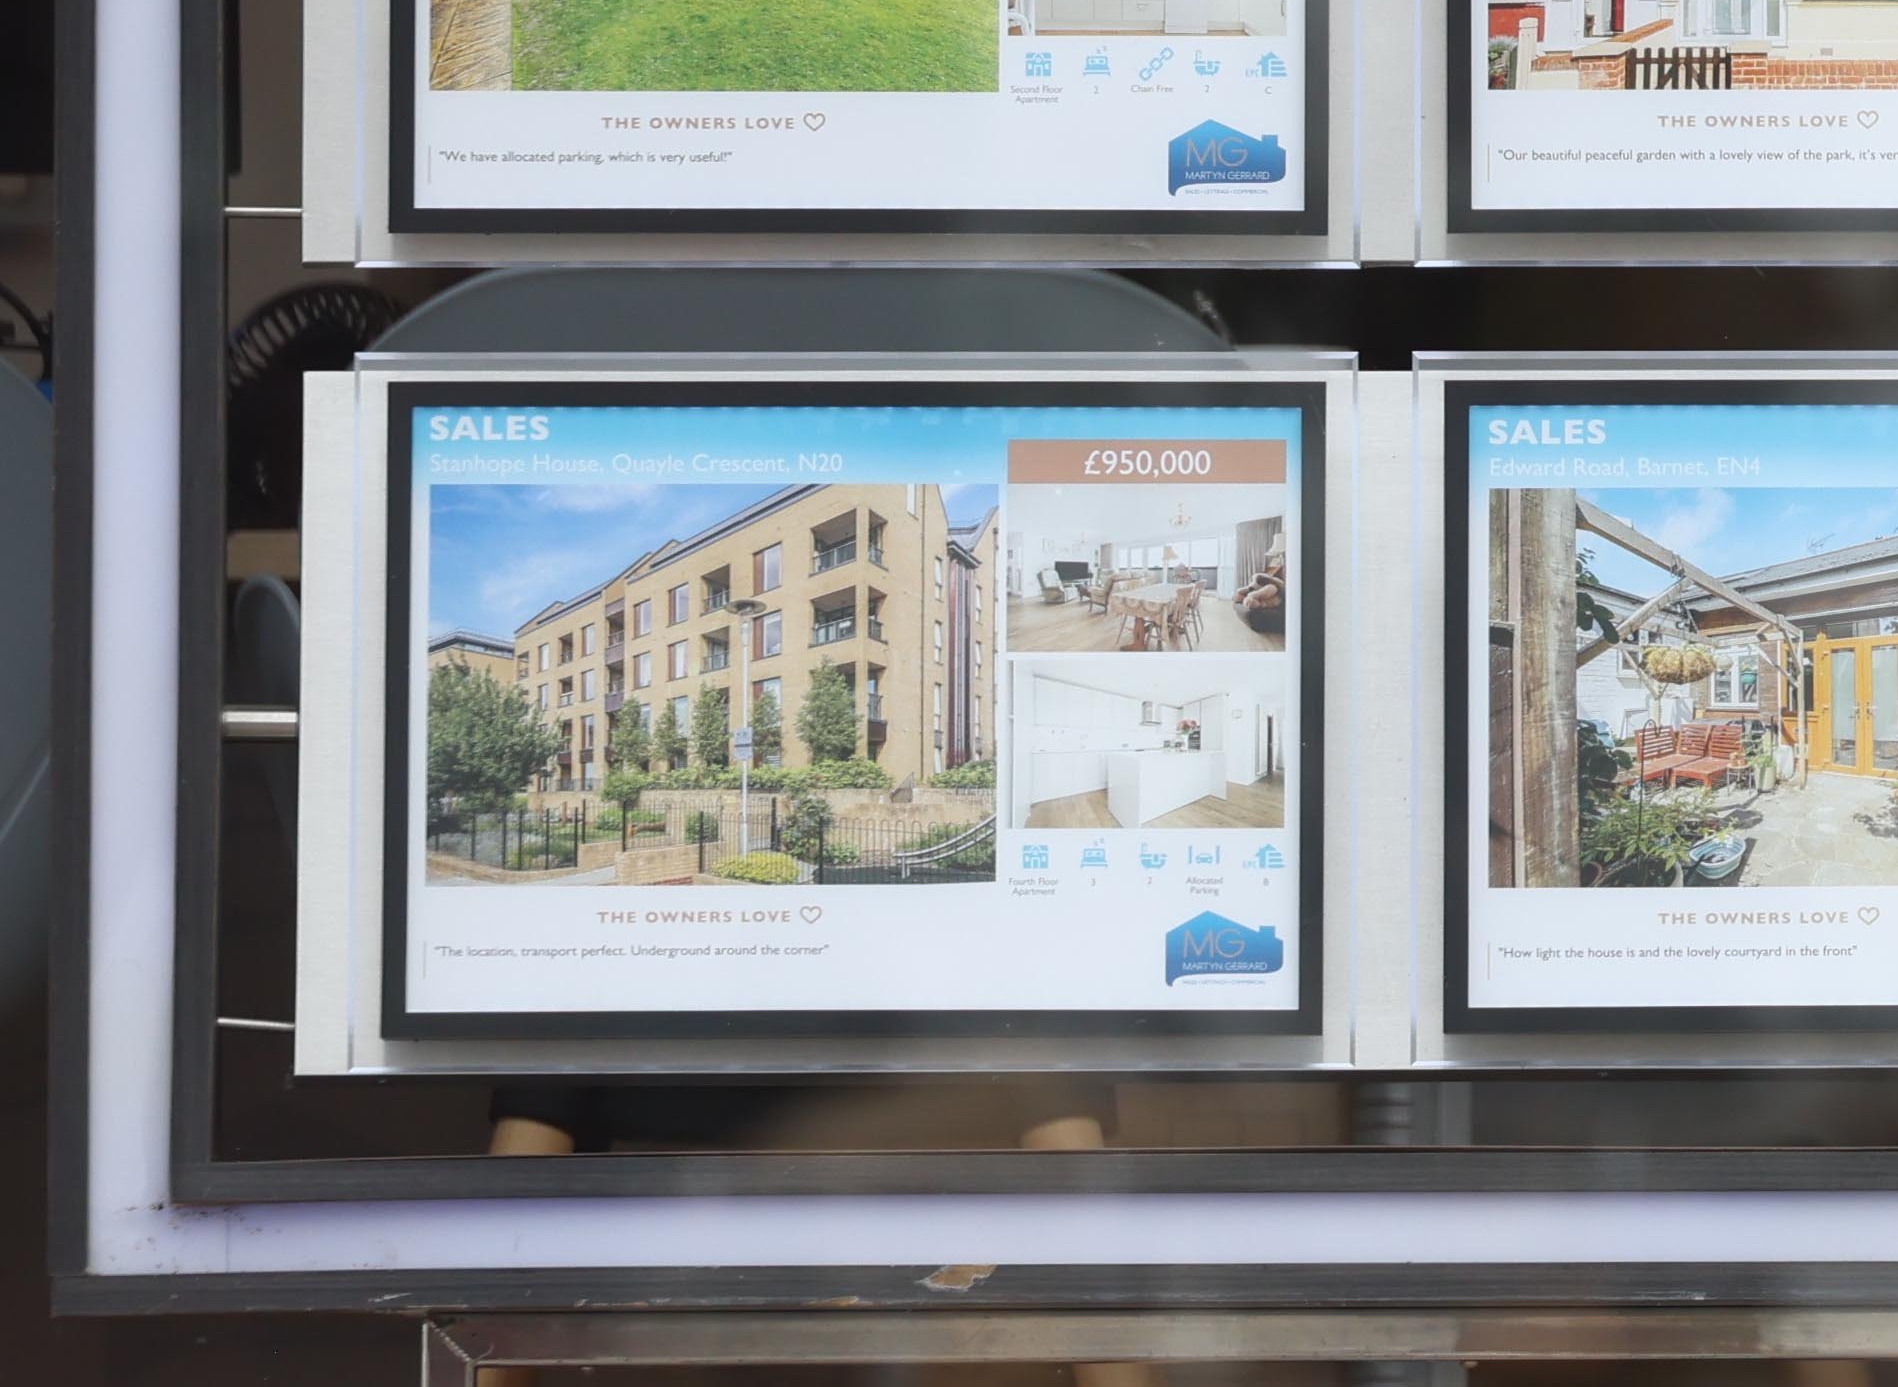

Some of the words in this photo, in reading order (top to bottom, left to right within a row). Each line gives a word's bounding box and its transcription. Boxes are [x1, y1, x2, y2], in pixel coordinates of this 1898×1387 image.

[1009, 85, 1041, 95] Second
[1041, 83, 1064, 94] Floor
[1129, 84, 1155, 93] Chain
[1155, 84, 1175, 93] Free
[1014, 96, 1059, 105] Apartment
[601, 117, 640, 129] THE
[650, 118, 736, 129] OWNERS
[745, 118, 794, 129] LOVE
[1658, 116, 1696, 128] THE
[1705, 116, 1790, 127] OWNERS
[1800, 116, 1848, 127] LOVE
[469, 151, 499, 163] have
[501, 151, 555, 163] allocated
[607, 151, 644, 163] which
[646, 153, 657, 163] is
[659, 154, 686, 165] very
[1185, 137, 1248, 167] MG
[1531, 149, 1582, 161] beautiful
[1586, 149, 1632, 163] peaceful
[1636, 150, 1676, 163] garden
[1679, 149, 1706, 161] with
[1709, 151, 1716, 161] a
[1720, 150, 1753, 163] lovely
[1756, 151, 1785, 161] view
[1788, 149, 1800, 160] of
[1803, 149, 1823, 161] the
[1858, 149, 1876, 161] it's
[1185, 170, 1226, 181] MARTYN
[1226, 170, 1271, 181] GERRARD
[430, 416, 550, 441] SALES
[1489, 420, 1606, 444] SALES
[430, 454, 525, 478] Stanhope
[612, 454, 684, 476] Quayle
[800, 454, 842, 472] N20
[1084, 450, 1211, 478] £950,000
[1490, 456, 1566, 476] Edward
[1718, 457, 1760, 475] EN4
[1008, 877, 1037, 887] Fourth
[1037, 876, 1059, 887] Floor
[1185, 876, 1224, 886] Allocated
[1011, 888, 1056, 897] Apartment
[1189, 887, 1220, 897] Parking
[596, 912, 636, 923] THE
[646, 911, 732, 923] OWNERS
[742, 911, 790, 922] LOVE
[1658, 913, 1696, 924] THE
[1706, 912, 1790, 924] OWNERS
[1800, 912, 1848, 924] LOVE
[1183, 928, 1246, 958] MG
[520, 947, 578, 959] transport
[631, 946, 710, 958] Underground
[713, 944, 758, 956] around
[761, 944, 780, 955] the
[1536, 948, 1560, 961] light
[1564, 947, 1585, 959] the
[1587, 947, 1623, 959] house
[1626, 947, 1636, 958] is
[1638, 946, 1660, 958] and
[1663, 946, 1684, 958] the
[1687, 946, 1720, 960] lovely
[1725, 946, 1781, 959] courtyard
[1785, 945, 1797, 957] in
[1799, 945, 1820, 957] the
[1181, 961, 1223, 971] MARTYN
[1223, 961, 1269, 971] GERRARD
